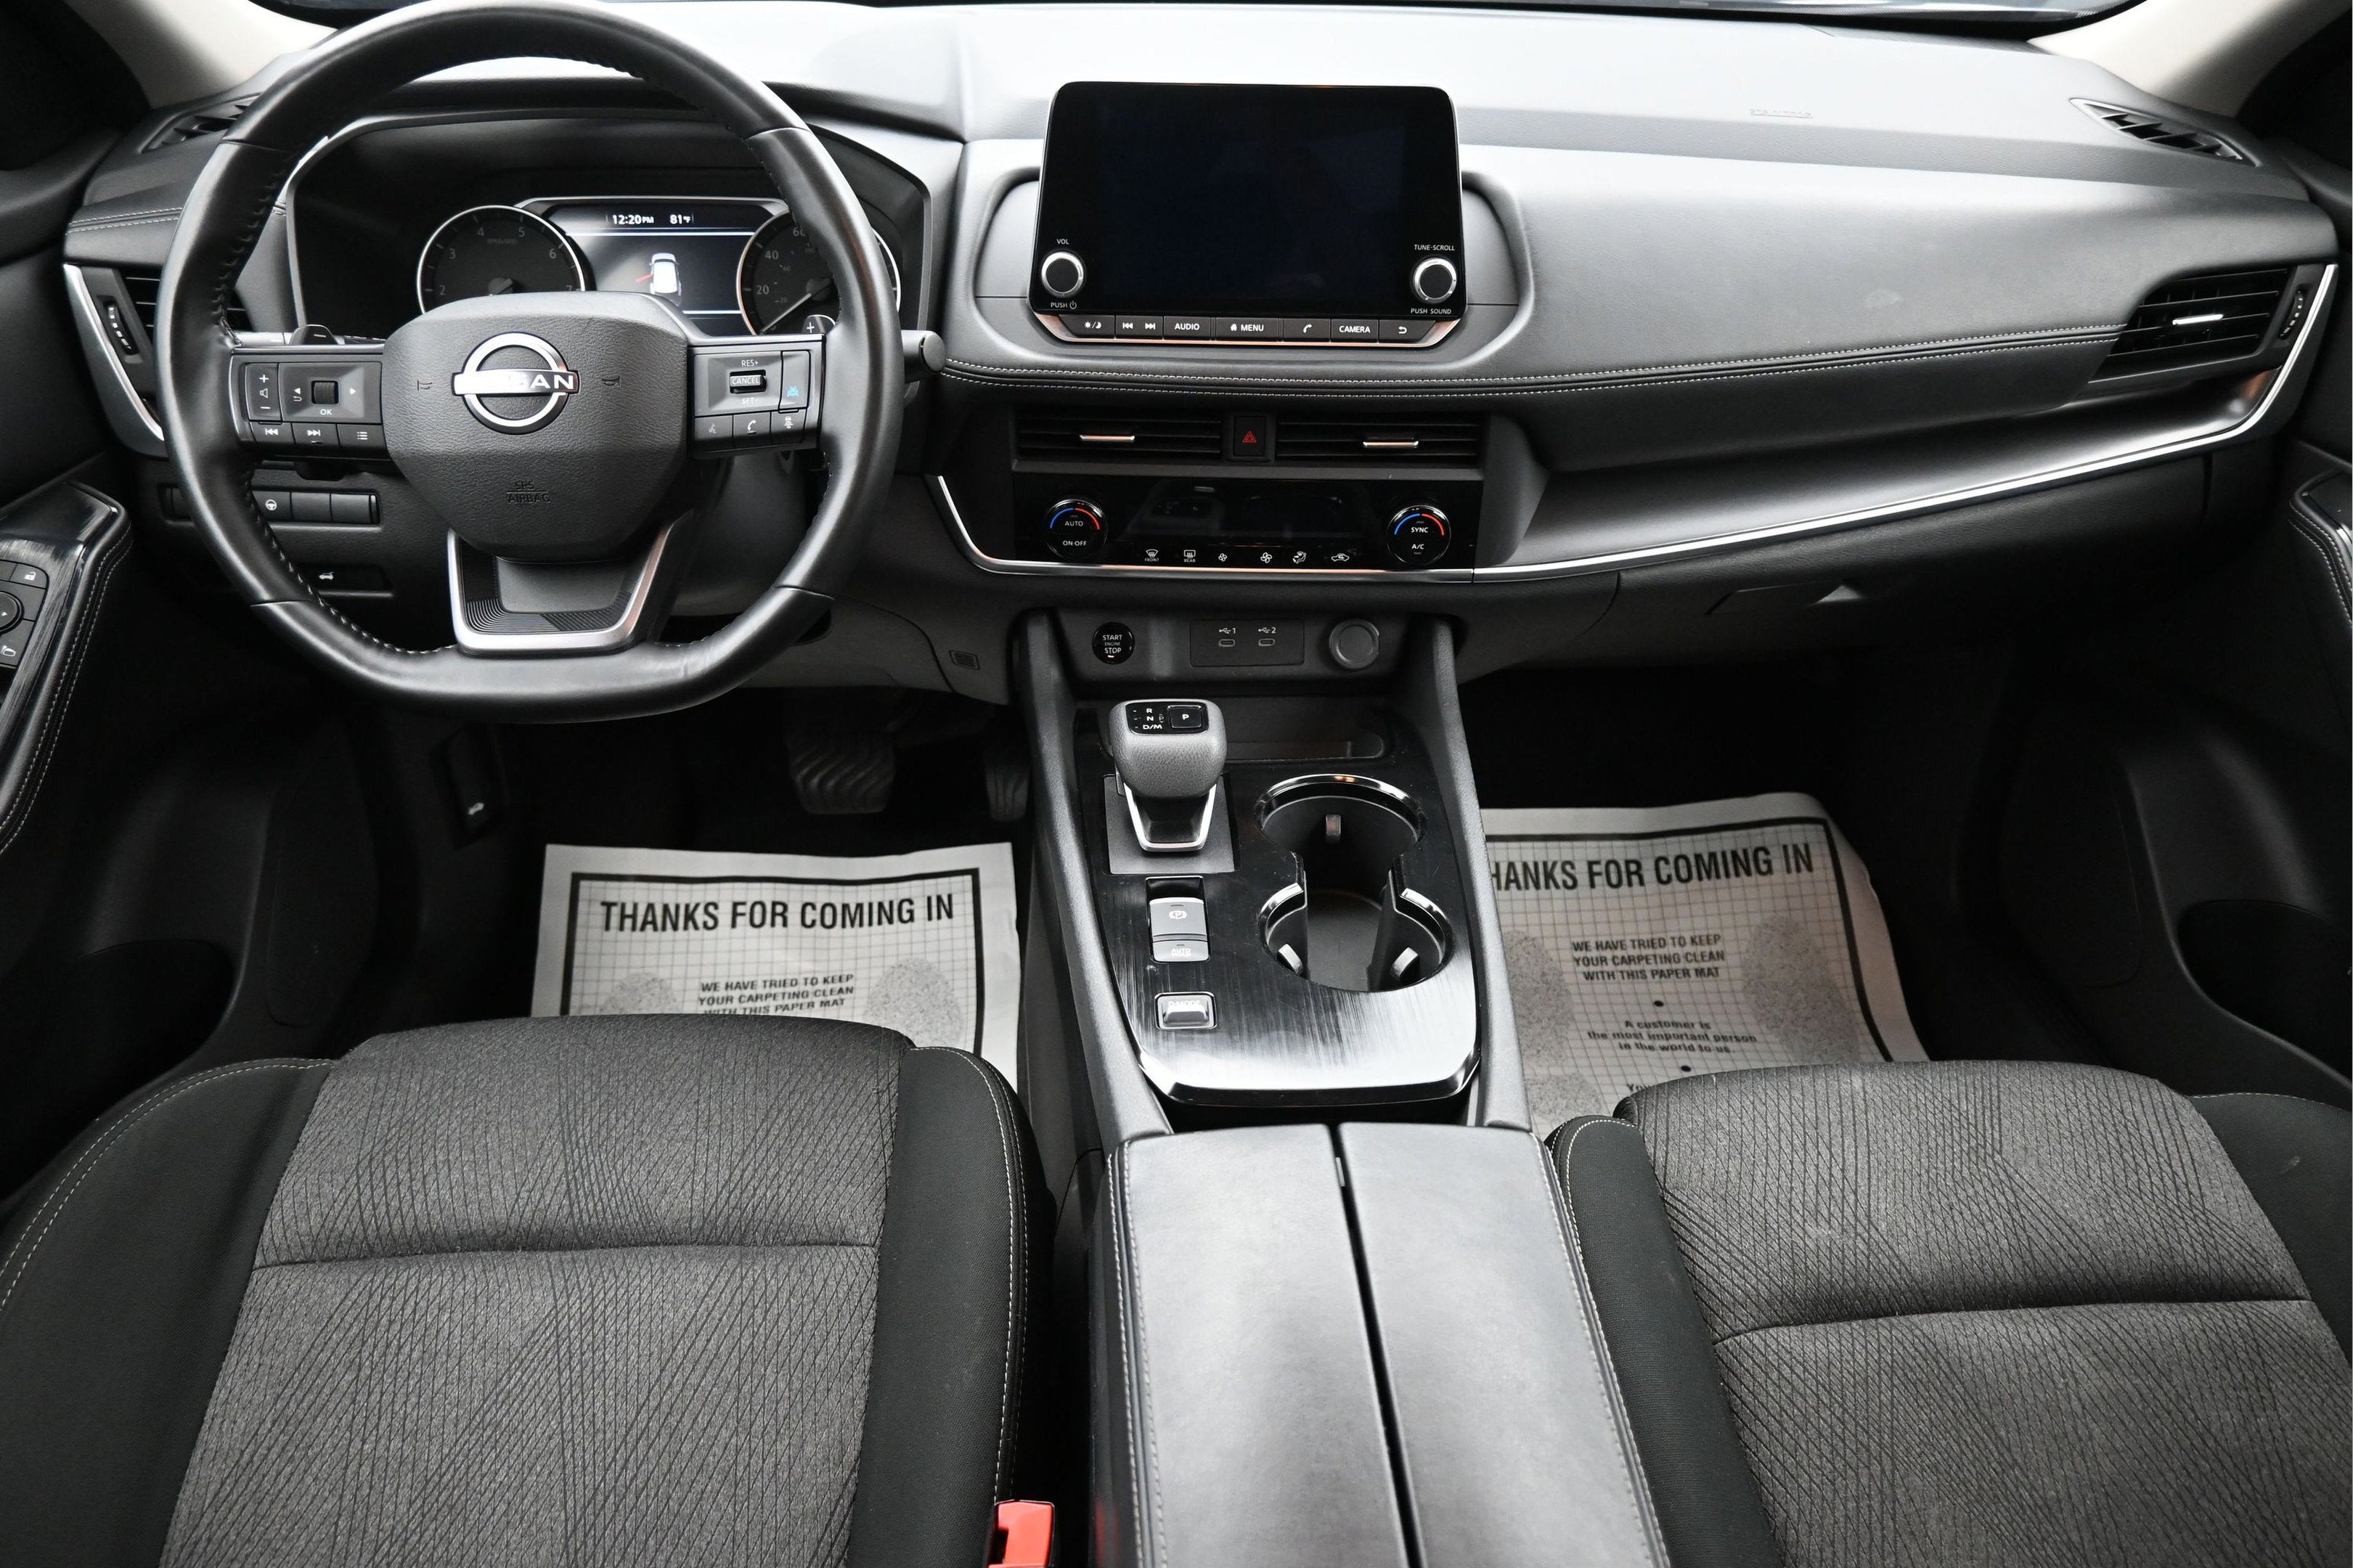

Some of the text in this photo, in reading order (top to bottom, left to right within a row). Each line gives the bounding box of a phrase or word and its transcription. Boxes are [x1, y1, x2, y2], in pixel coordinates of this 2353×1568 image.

[478, 227, 484, 237] 4
[518, 227, 526, 237] 5
[449, 248, 456, 259] 3
[549, 248, 557, 259] 6
[764, 250, 779, 260] 40
[439, 285, 446, 295] 2
[757, 285, 770, 295] 20
[1240, 324, 1265, 332] MENU
[1339, 325, 1371, 334] CAMERA
[1490, 842, 1814, 891] HANKS FOR COMING IN
[600, 893, 954, 932] THANKS FOR COMING IN
[1573, 934, 1721, 952] WE HAVE TRIED TO KEEP
[1573, 950, 1726, 967] YOUR CARPETING CLEAN
[1583, 966, 1721, 981] WITH THIS PAPER MAT
[701, 973, 854, 992] WE HAVE TRIED TO KEEP
[699, 987, 854, 1006] YOUR CARPETING CLEAN
[775, 1000, 815, 1013] PAPER
[820, 998, 845, 1008] MAT
[1636, 1021, 1695, 1029] customer
[1700, 1021, 1712, 1030] is
[1587, 1031, 1608, 1040] the
[1647, 1032, 1710, 1042] important
[1659, 1044, 1696, 1053] world
[1698, 1044, 1712, 1053] to
